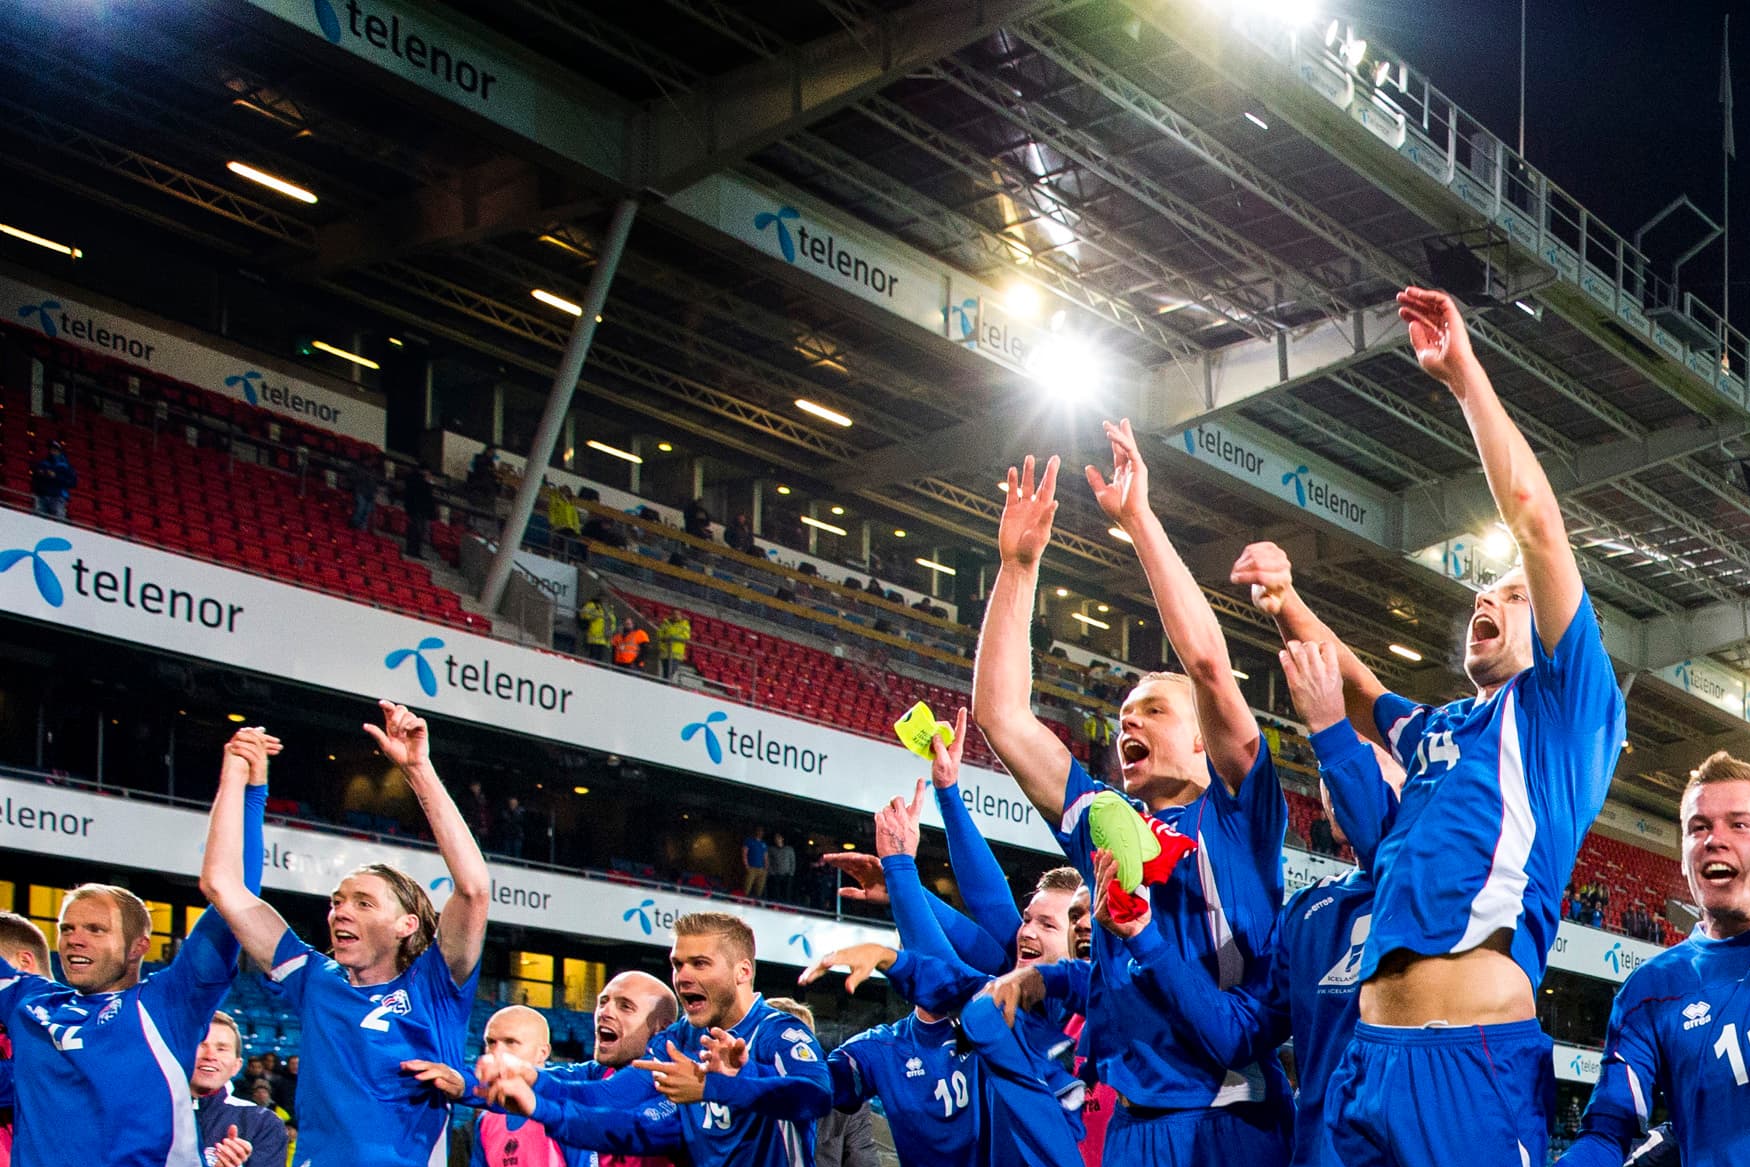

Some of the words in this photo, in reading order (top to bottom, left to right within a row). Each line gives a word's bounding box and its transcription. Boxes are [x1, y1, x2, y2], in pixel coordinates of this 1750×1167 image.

[346, 0, 497, 100] telenor
[798, 225, 899, 298] telenor
[60, 312, 155, 362] telenor
[261, 380, 342, 423] telenor
[1198, 425, 1264, 476] telenor
[1308, 479, 1367, 525] telenor
[73, 557, 244, 633] telenor
[446, 654, 573, 713] telenor
[727, 725, 828, 776] telenor
[0, 797, 95, 837] lenor
[962, 785, 1034, 825] elenor
[490, 875, 552, 911] lenor
[360, 994, 391, 1033] 2
[1683, 1014, 1712, 1031] errea
[934, 1070, 969, 1117] 10
